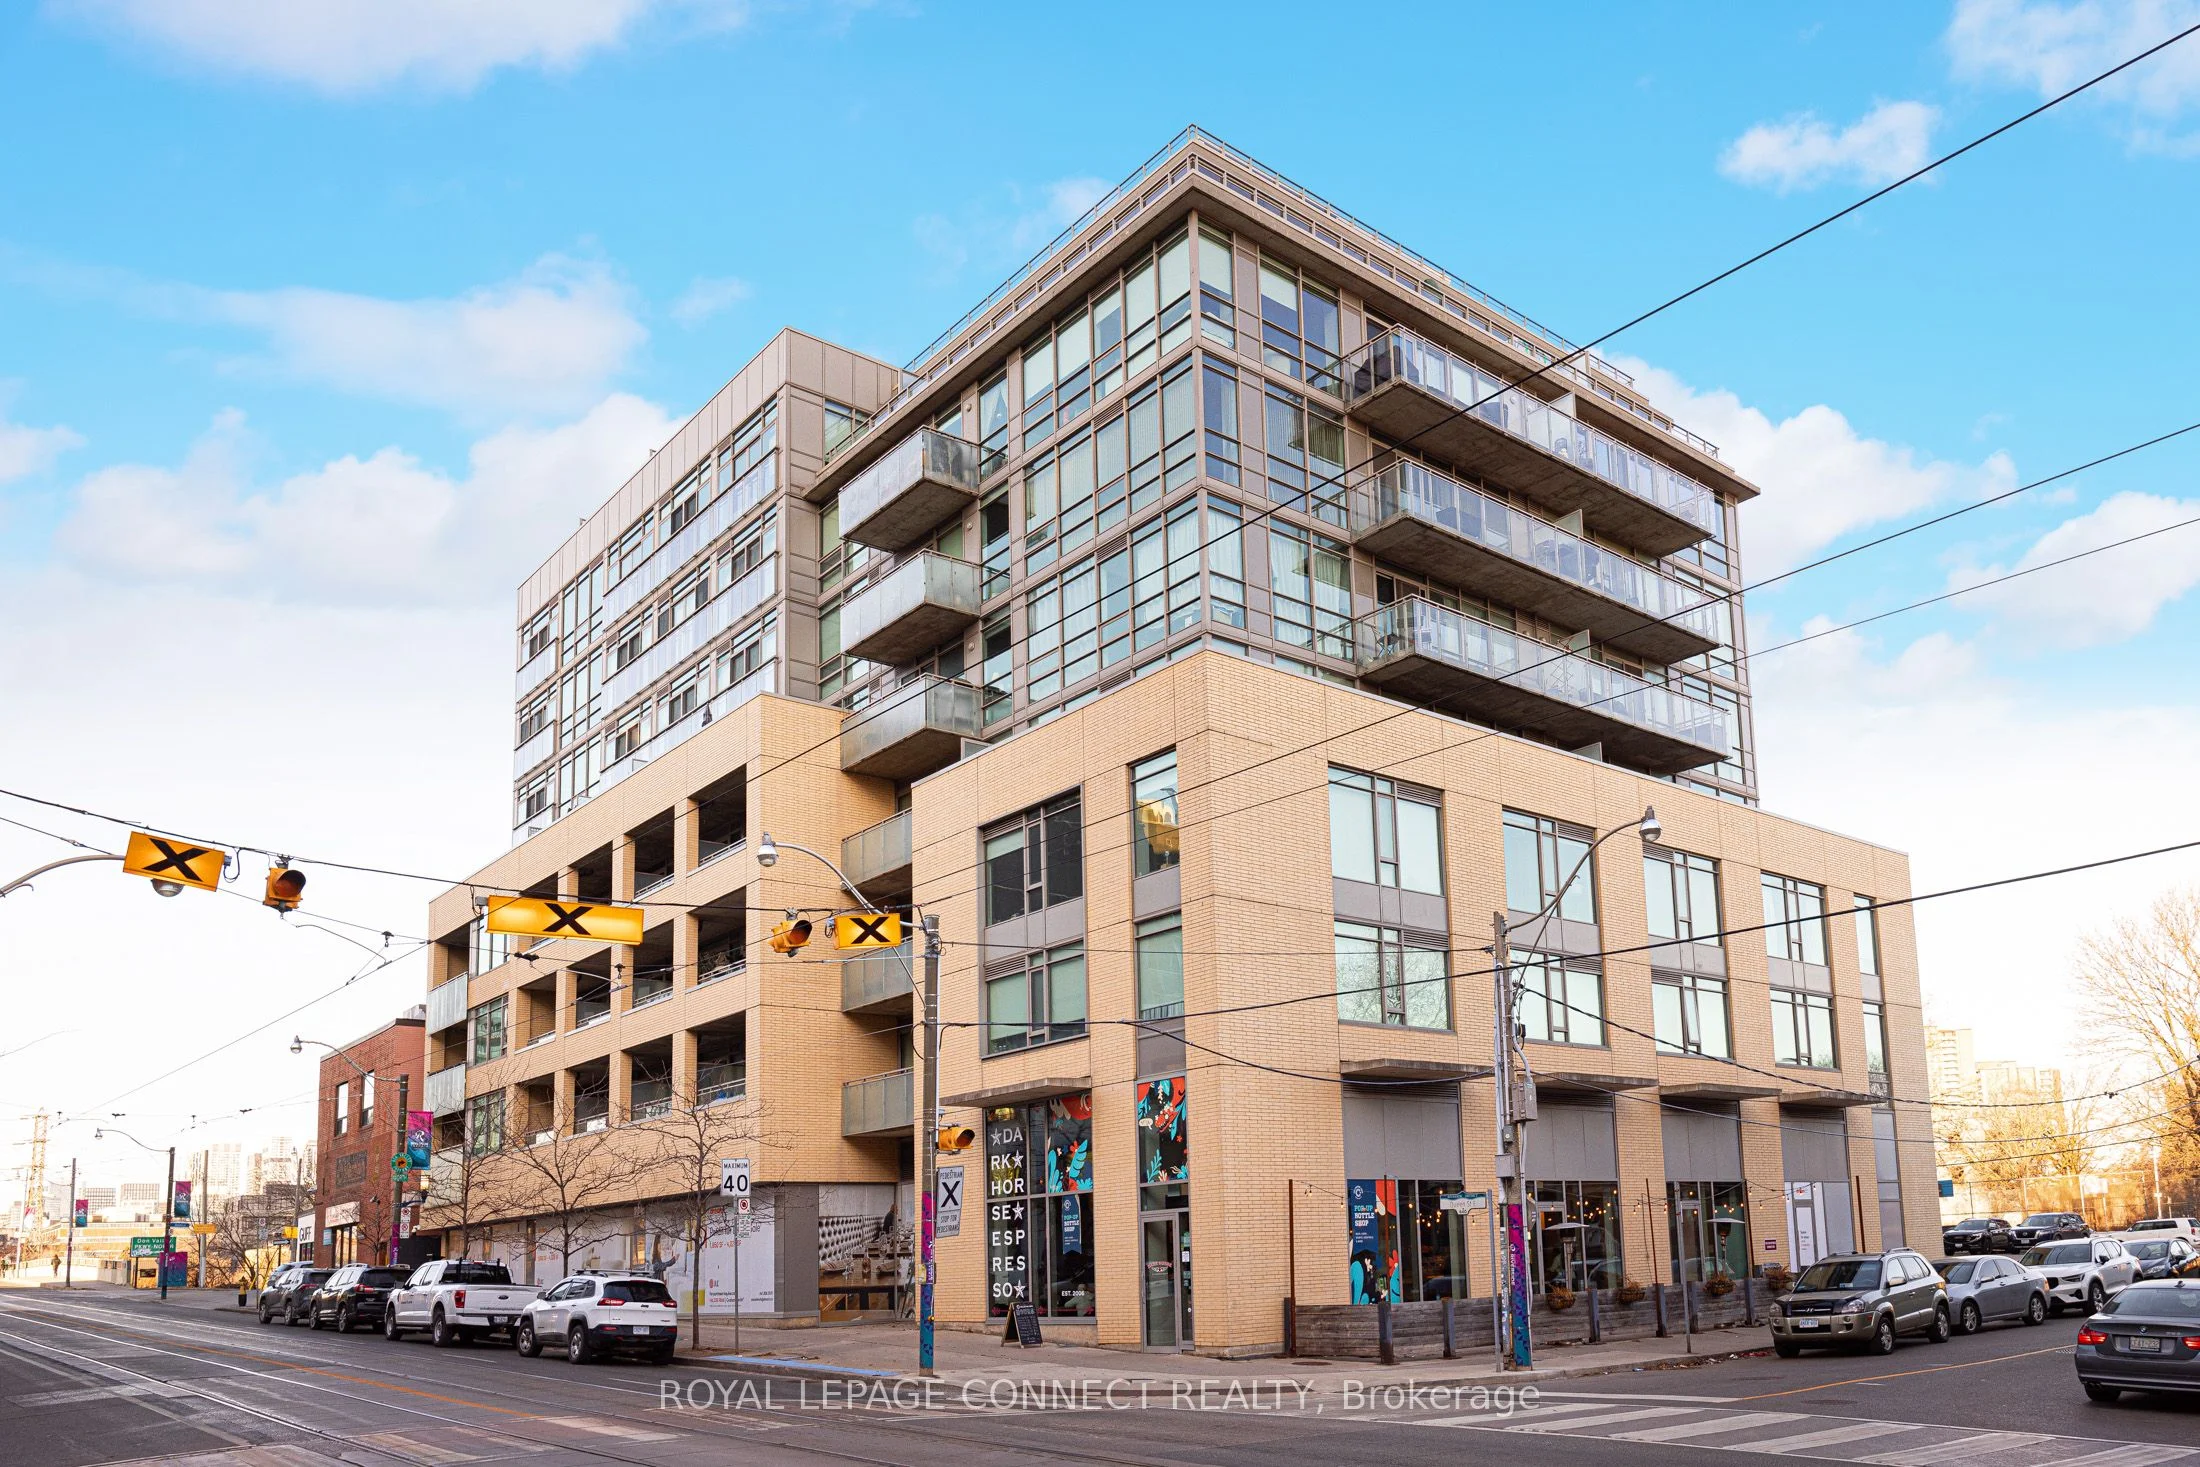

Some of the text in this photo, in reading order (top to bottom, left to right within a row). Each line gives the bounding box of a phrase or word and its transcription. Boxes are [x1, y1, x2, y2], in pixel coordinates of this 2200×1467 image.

[723, 1174, 749, 1192] 40
[940, 1171, 962, 1180] PEDESTRIAN
[991, 1178, 1024, 1196] HOR
[941, 1215, 949, 1223] STOP
[992, 1205, 1011, 1220] SE
[937, 1223, 960, 1233] PEDESTRIANS
[992, 1229, 1025, 1246] ESP
[992, 1255, 1026, 1272] RES
[993, 1282, 1013, 1298] SO
